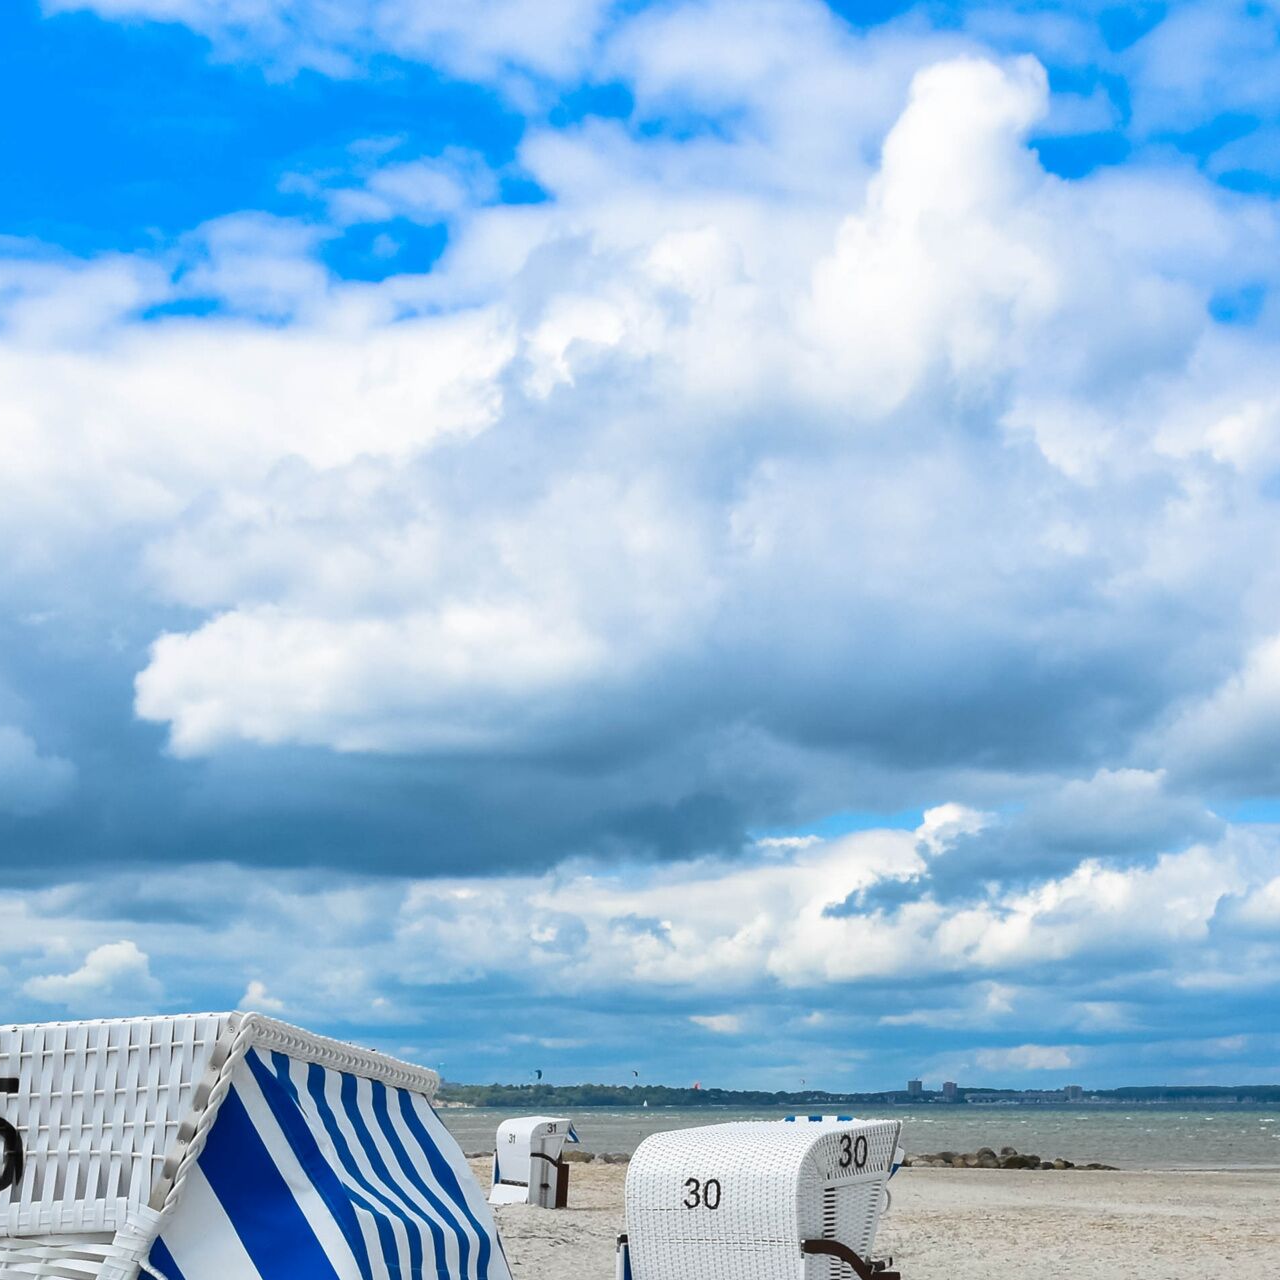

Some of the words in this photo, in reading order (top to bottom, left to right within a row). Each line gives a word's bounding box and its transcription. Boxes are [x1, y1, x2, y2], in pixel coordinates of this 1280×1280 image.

[508, 1133, 516, 1144] 31
[547, 1122, 557, 1134] 31
[839, 1134, 868, 1168] 30
[683, 1177, 721, 1210] 30
